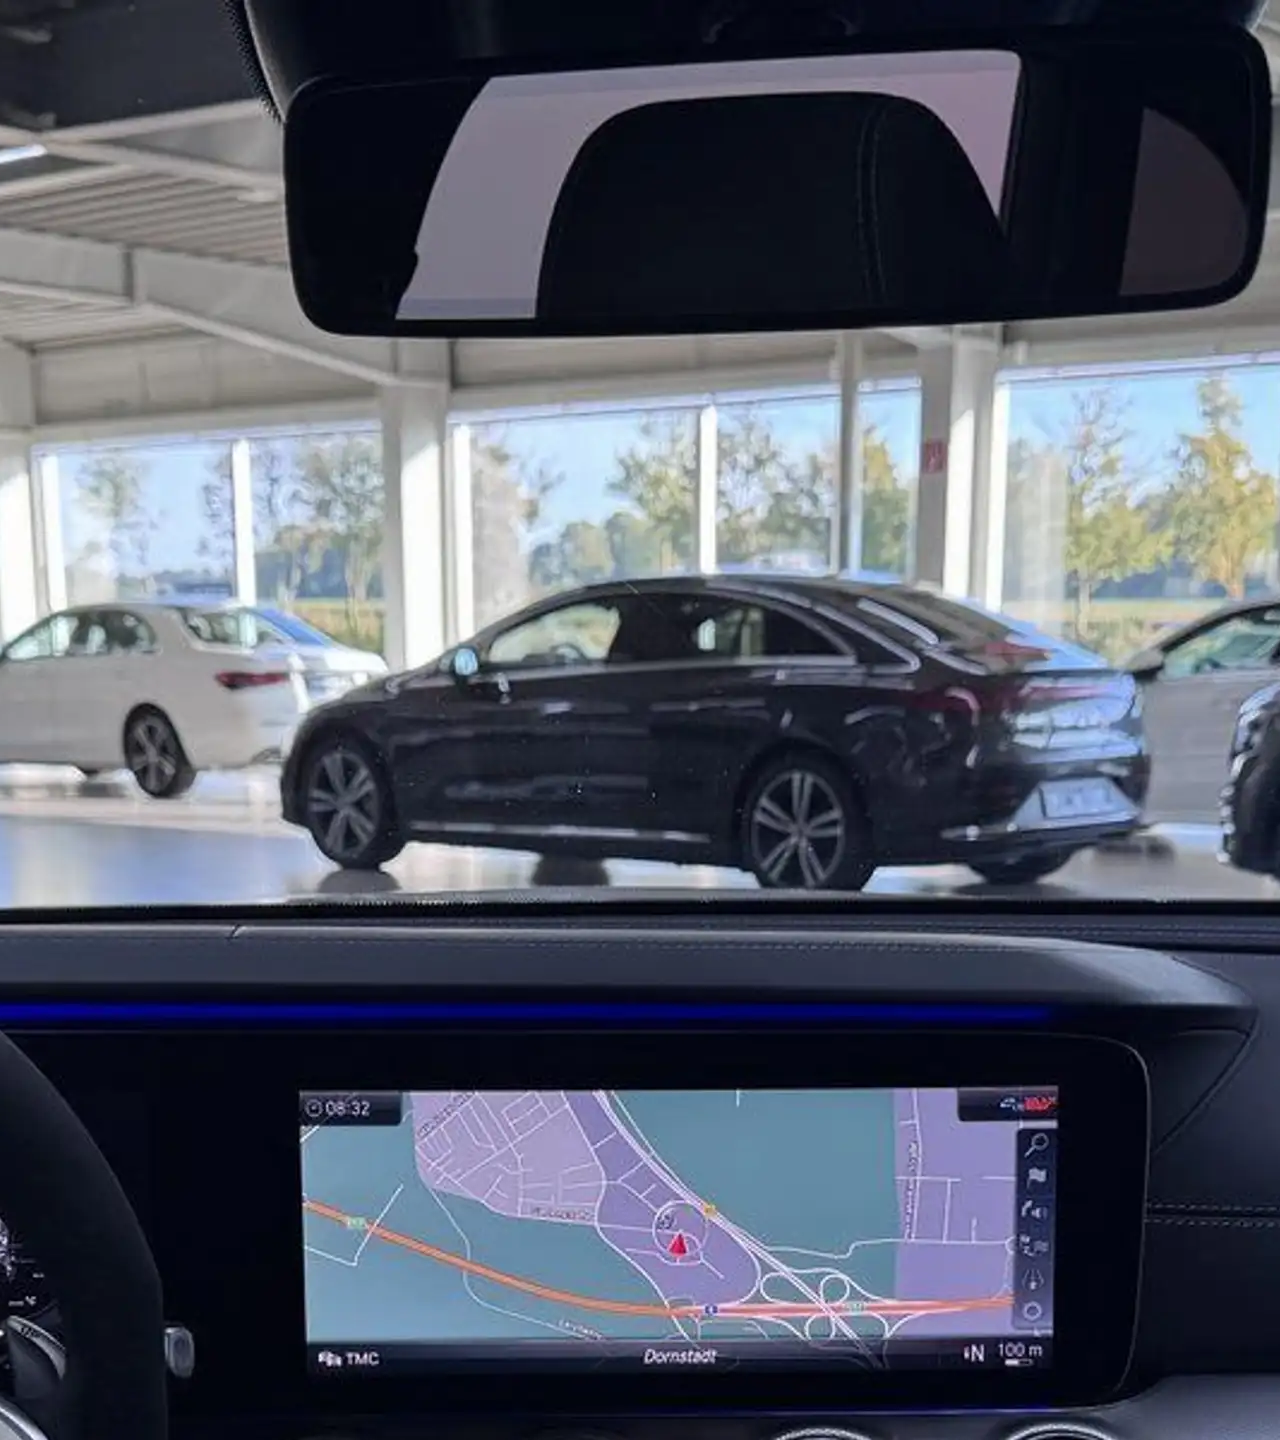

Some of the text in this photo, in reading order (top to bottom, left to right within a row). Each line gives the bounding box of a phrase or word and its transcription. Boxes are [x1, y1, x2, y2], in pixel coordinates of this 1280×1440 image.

[325, 1101, 370, 1116] 08:32
[345, 1352, 380, 1366] TMC
[643, 1346, 718, 1364] Dornstadt
[970, 1344, 986, 1362] N
[997, 1343, 1044, 1359] 100 m
